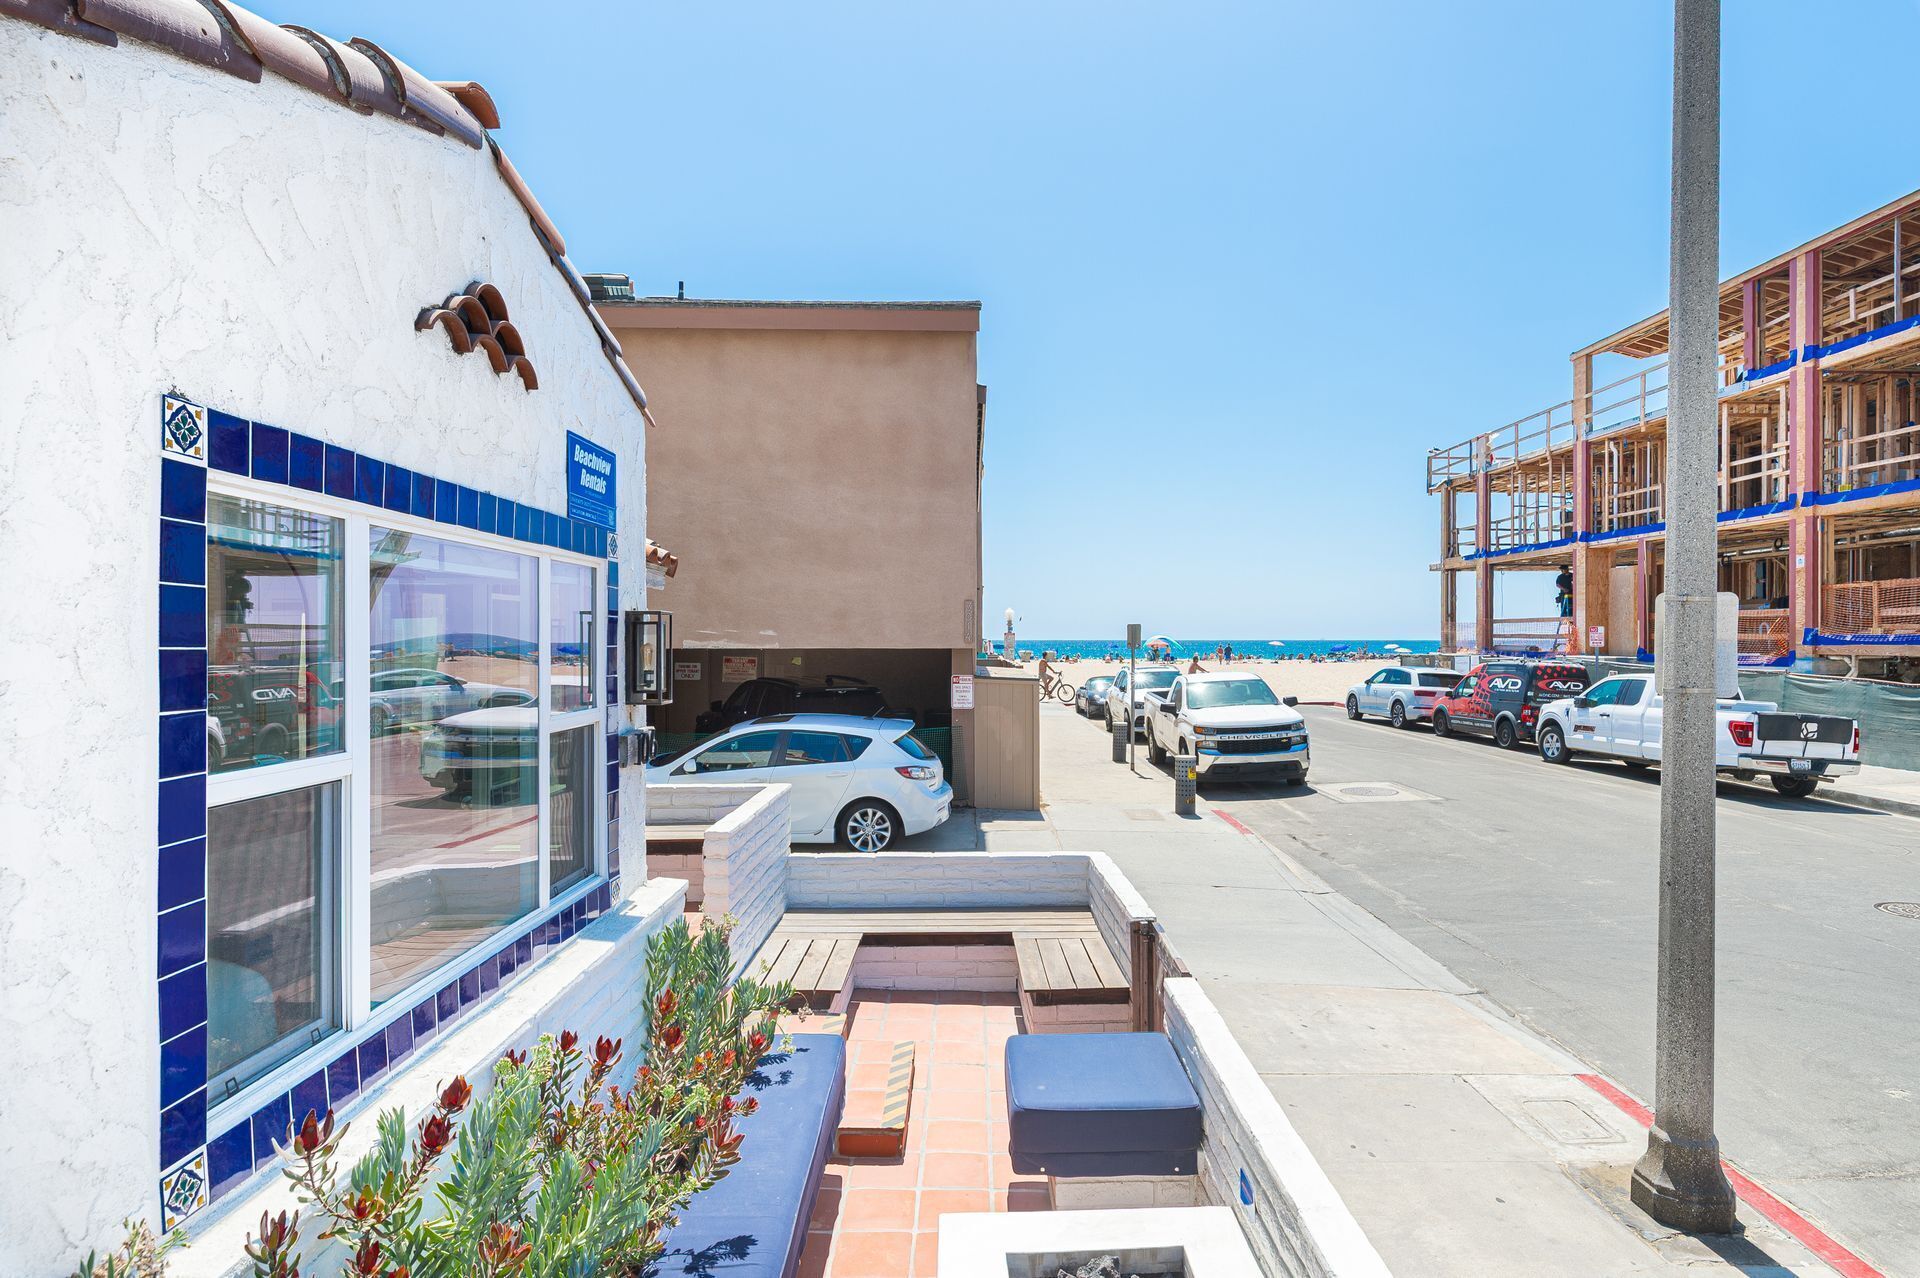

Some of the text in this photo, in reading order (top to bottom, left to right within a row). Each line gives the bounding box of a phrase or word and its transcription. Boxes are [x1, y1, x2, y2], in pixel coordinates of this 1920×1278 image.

[574, 444, 611, 476] Beachview
[580, 468, 607, 494] Rentals
[1488, 678, 1522, 689] AVD
[1548, 681, 1584, 690] AVD
[1219, 732, 1290, 740] CHEVROLET
